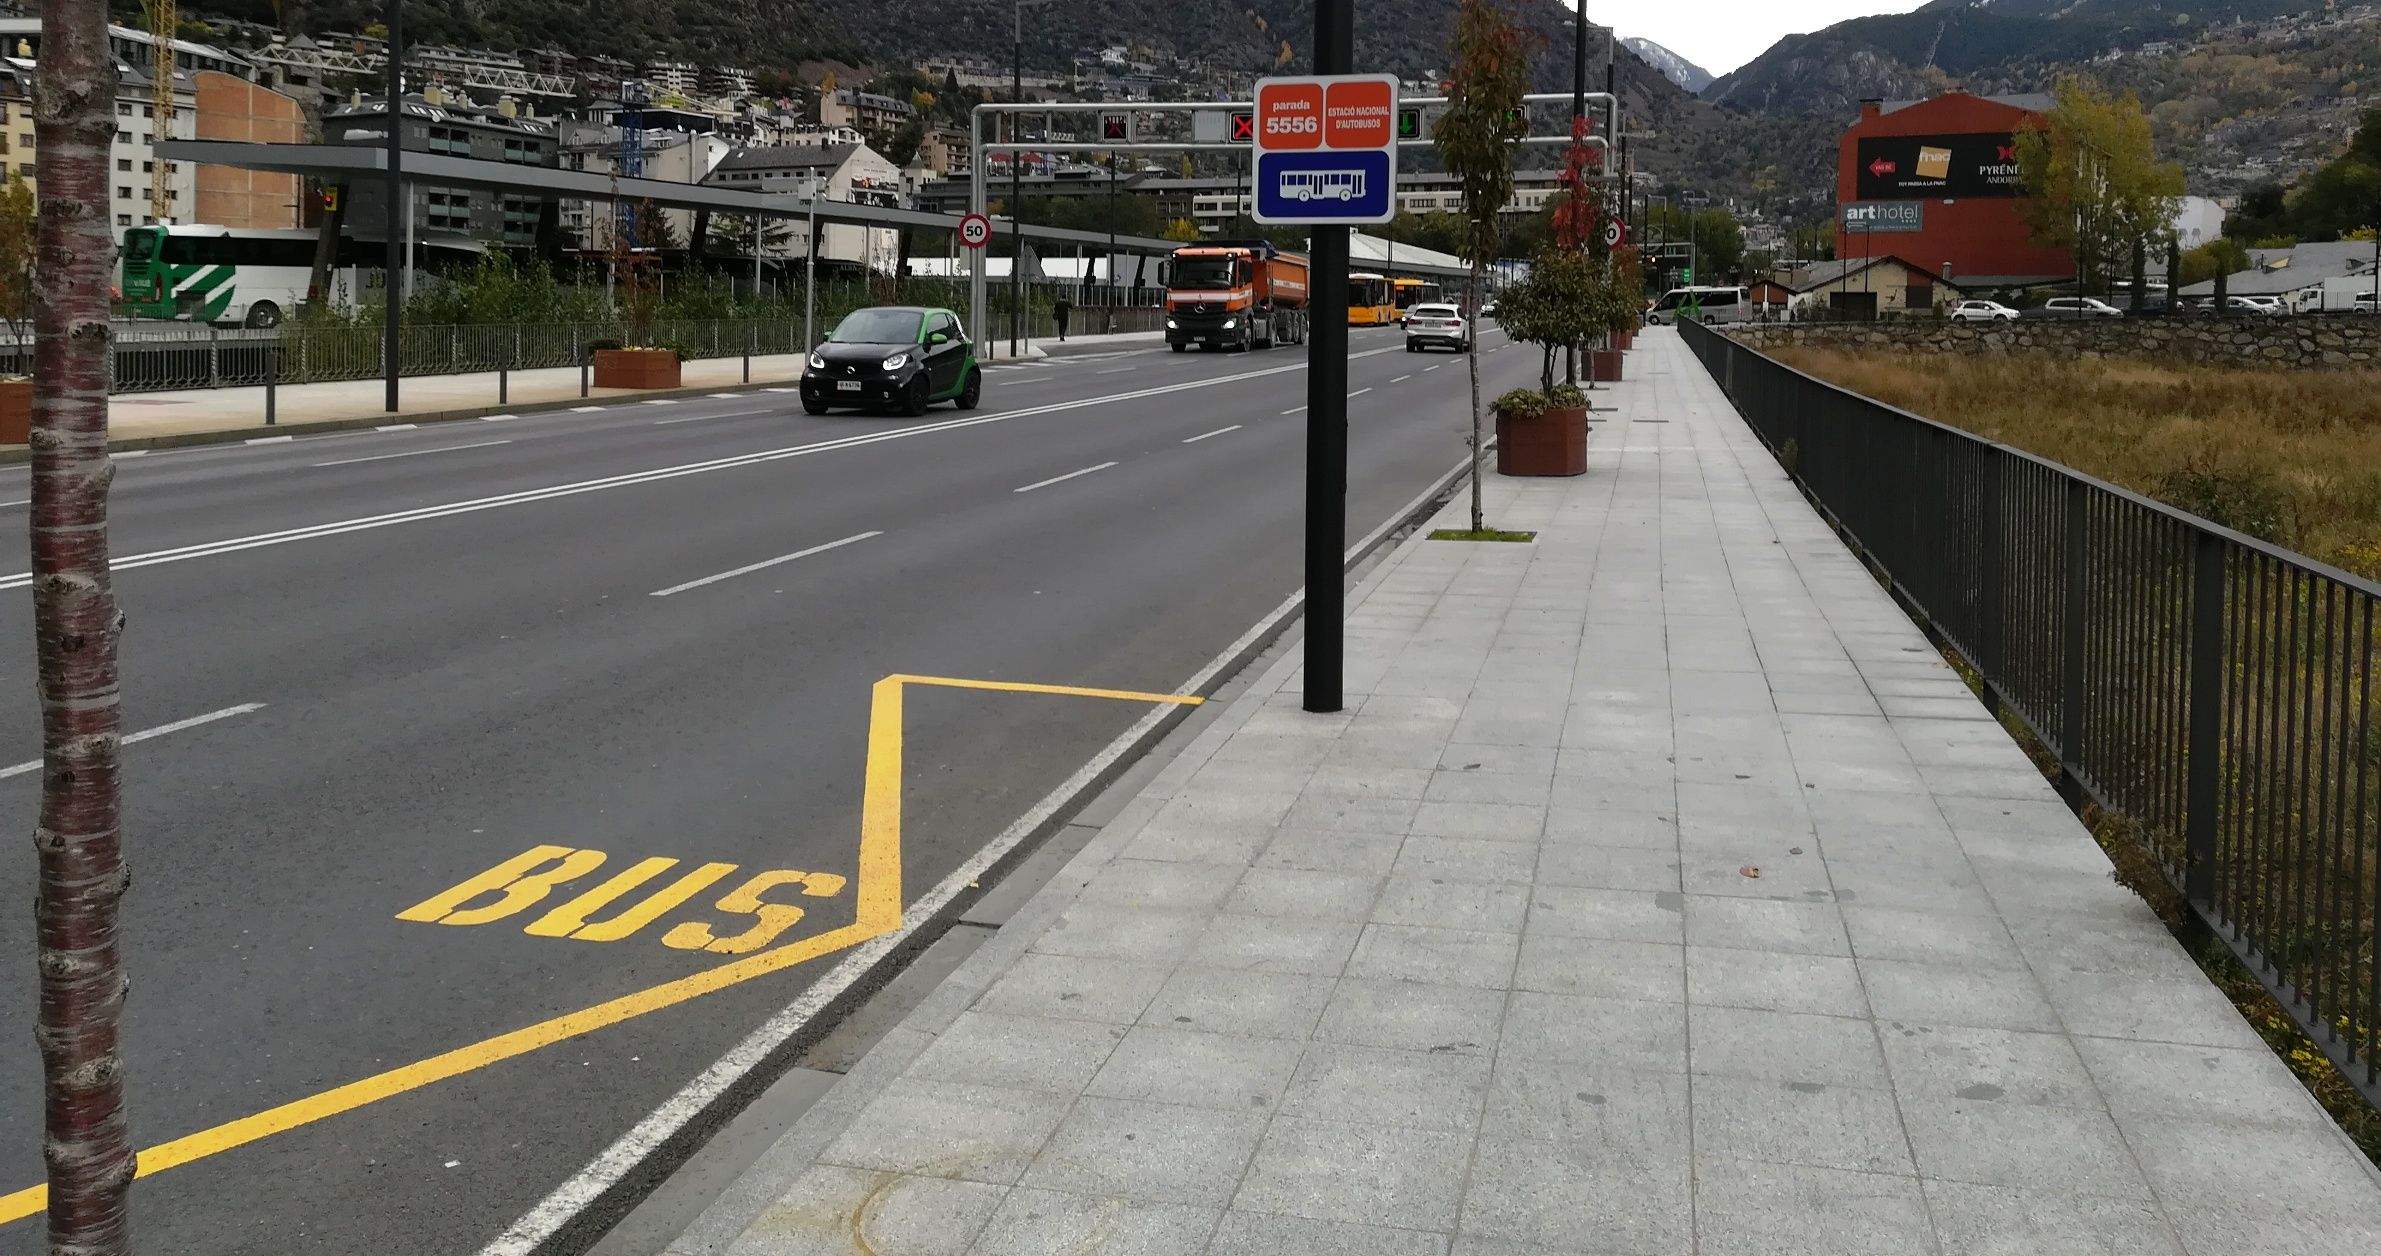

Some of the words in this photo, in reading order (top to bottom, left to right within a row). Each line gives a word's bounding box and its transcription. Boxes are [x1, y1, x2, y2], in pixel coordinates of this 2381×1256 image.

[1273, 100, 1310, 112] parada
[1328, 106, 1357, 117] ESTACIÓ
[1357, 105, 1390, 116] NACIONAL
[1266, 116, 1318, 134] 5556
[1335, 118, 1381, 129] D'AUTOBUSOS
[1919, 151, 1950, 162] fnac
[1847, 204, 1918, 219] arthotel
[966, 225, 983, 236] 50
[395, 844, 846, 953] BUS
